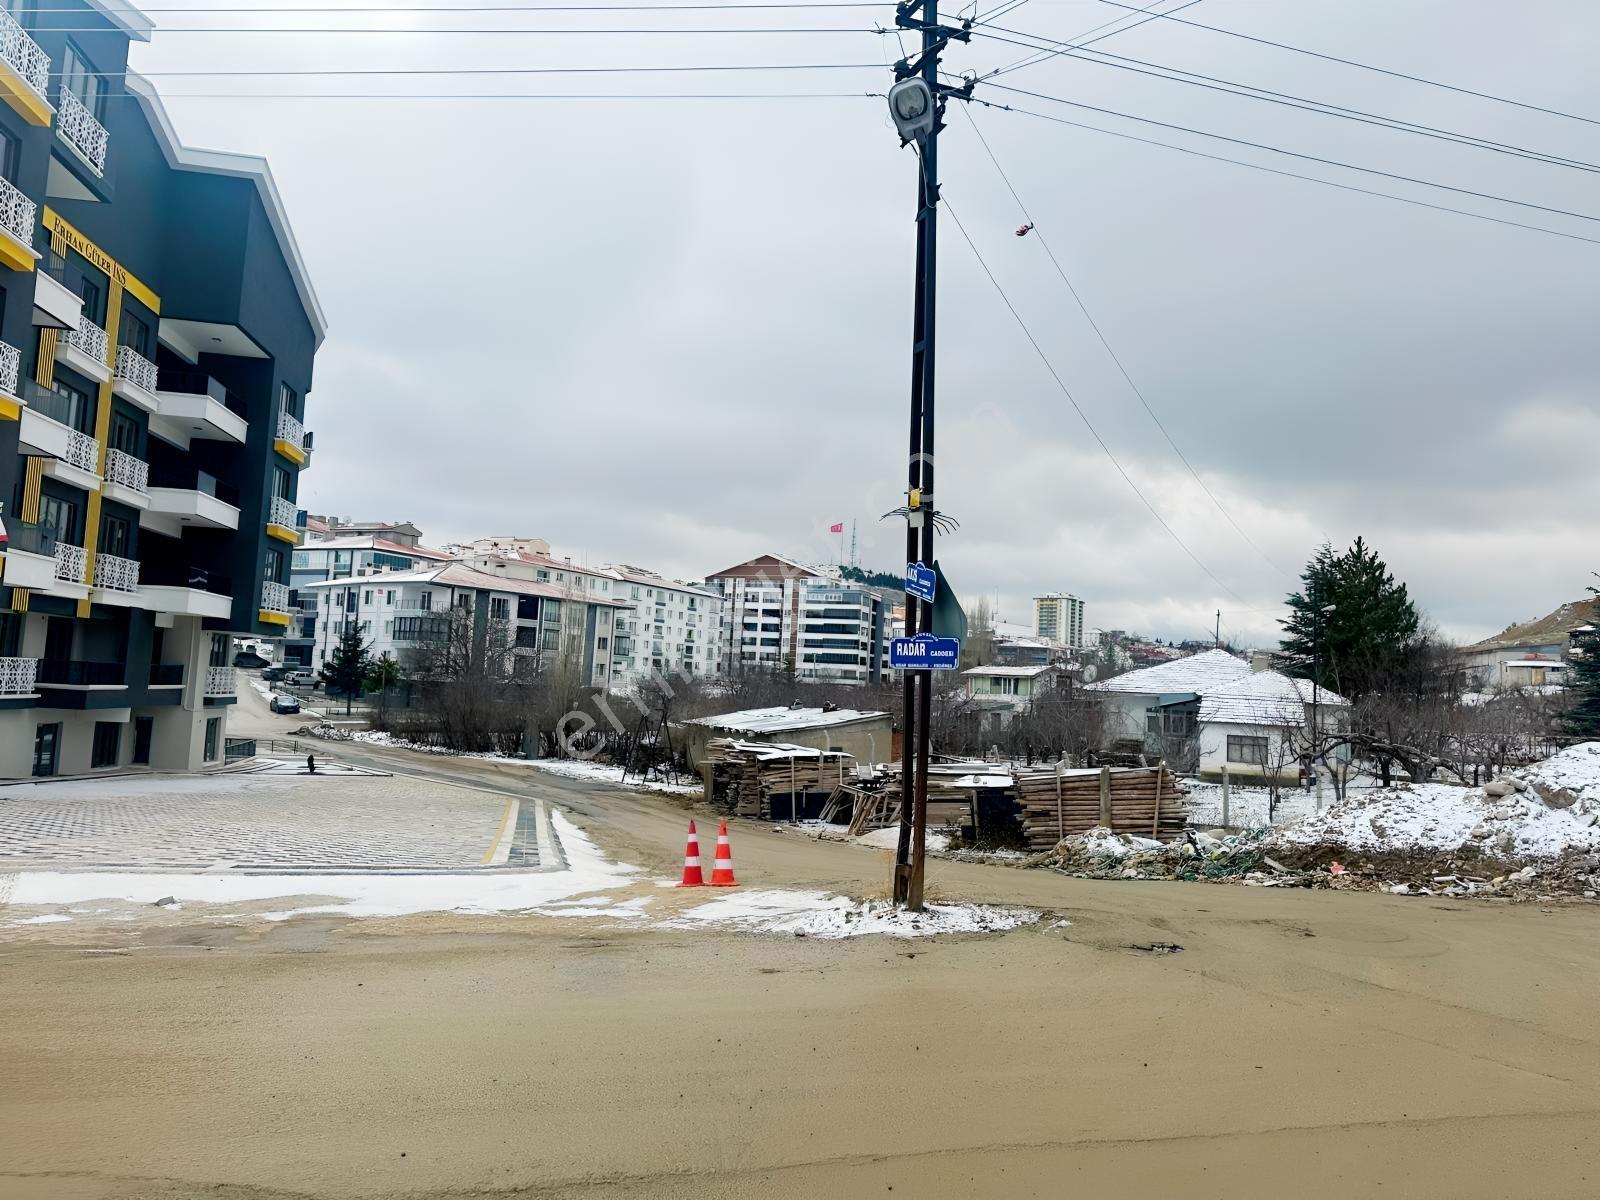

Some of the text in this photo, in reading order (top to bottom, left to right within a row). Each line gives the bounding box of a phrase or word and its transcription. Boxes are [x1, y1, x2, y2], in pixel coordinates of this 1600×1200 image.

[53, 216, 84, 252] ERHAN
[85, 243, 111, 273] GÜLER
[897, 642, 926, 656] RADAR
